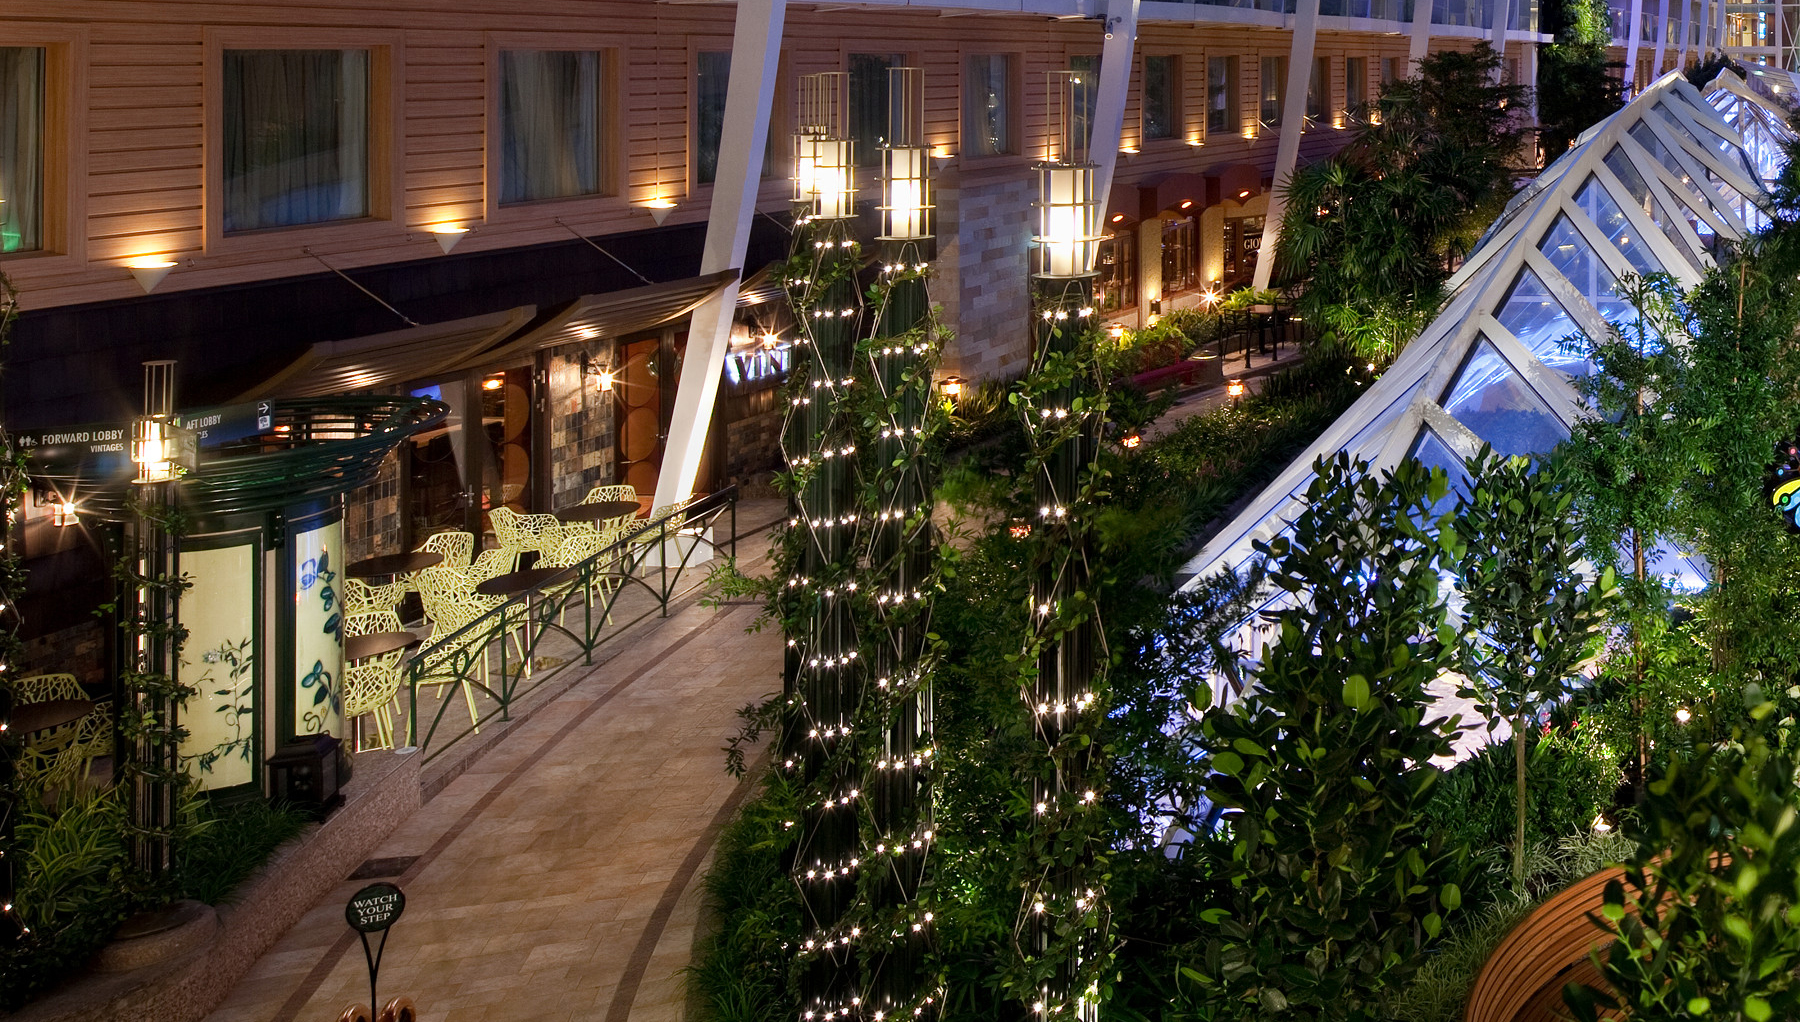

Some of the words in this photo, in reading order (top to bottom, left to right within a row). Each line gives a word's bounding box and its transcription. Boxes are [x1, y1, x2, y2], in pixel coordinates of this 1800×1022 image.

[733, 349, 792, 382] VIN
[185, 418, 199, 430] AFT
[199, 414, 222, 428] LOBBY
[42, 432, 90, 446] FORWARD
[92, 429, 124, 442] LOBBY
[90, 443, 124, 453] VINTAGES
[353, 893, 397, 908] WATCH
[357, 903, 394, 916] YOUR
[360, 912, 391, 925] STEP
